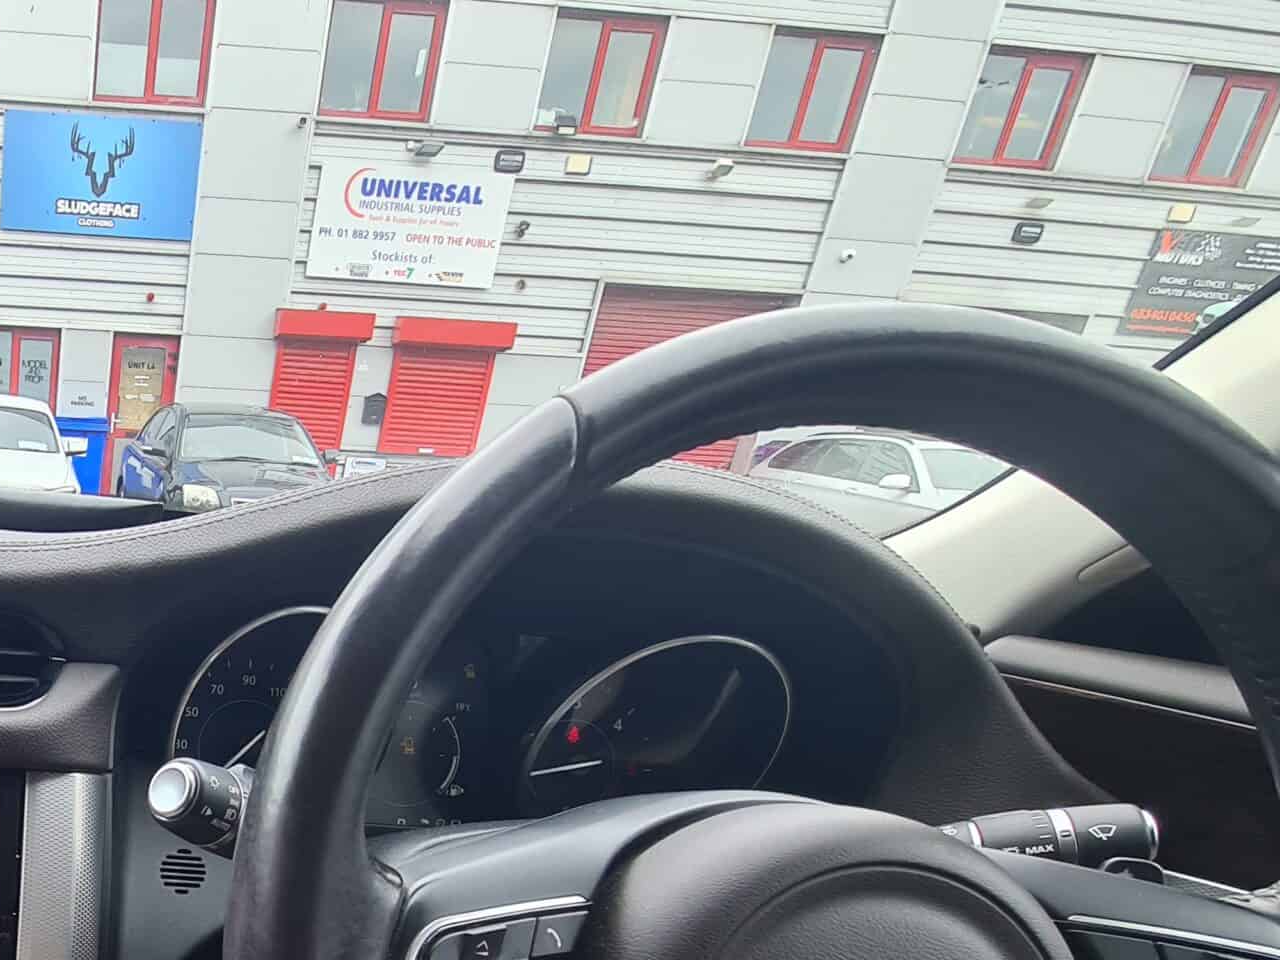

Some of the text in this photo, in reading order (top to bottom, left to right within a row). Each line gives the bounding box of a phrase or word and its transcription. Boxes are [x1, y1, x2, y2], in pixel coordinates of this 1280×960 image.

[360, 177, 483, 205] UNIVERSAL
[56, 199, 140, 219] SLUDGEFACE
[358, 199, 462, 217] INDUSTRIAL SUPPLIES
[78, 218, 114, 228] CLOTHING
[337, 229, 349, 238] 01
[352, 230, 370, 240] 882
[372, 231, 397, 242] 9957
[405, 233, 430, 246] OPEN
[431, 234, 445, 246] TO
[446, 235, 464, 247] THE
[465, 237, 497, 249] PUBLIC
[371, 250, 417, 264] Stockists
[22, 359, 48, 370] MODEL
[127, 361, 145, 369] UNIT
[24, 374, 44, 385] PROP
[242, 675, 256, 686] 90
[210, 683, 225, 695] 70
[184, 706, 199, 718] 50
[1025, 844, 1055, 855] MAX
